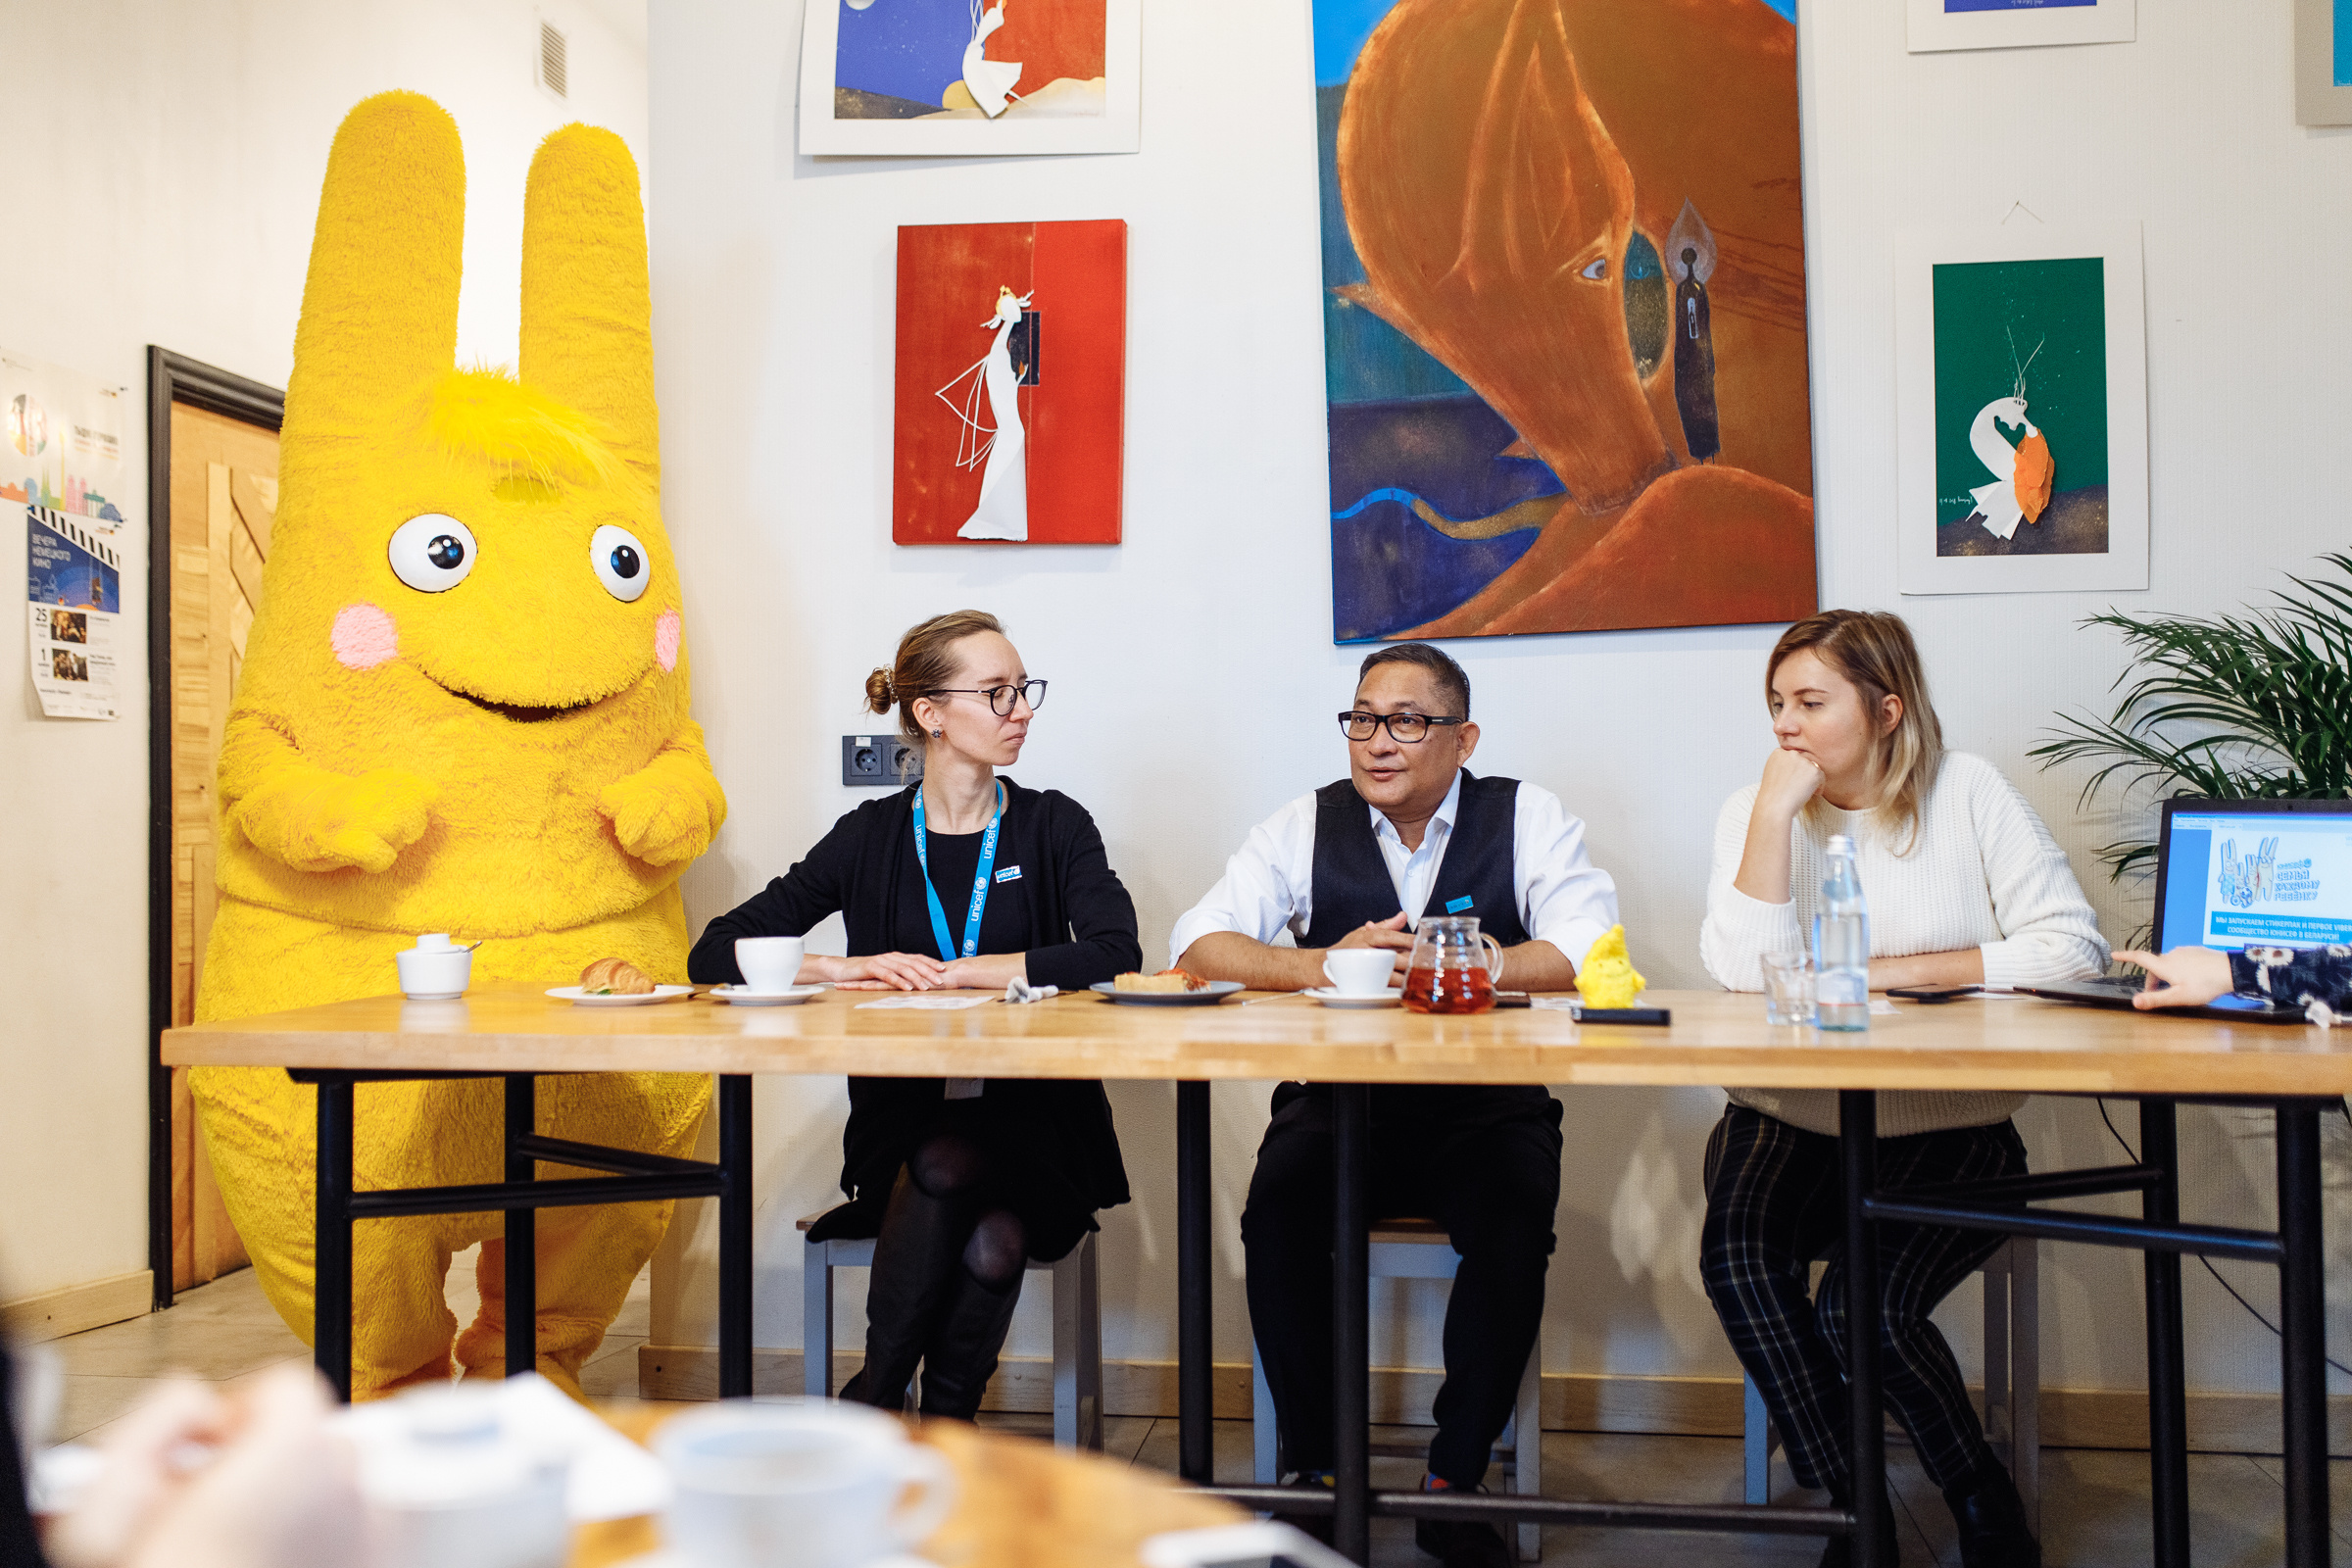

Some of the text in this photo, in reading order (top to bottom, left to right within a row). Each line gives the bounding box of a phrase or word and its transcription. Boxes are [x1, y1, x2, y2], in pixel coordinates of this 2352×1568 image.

[35, 608, 48, 622] 25
[915, 824, 925, 856] unicef
[984, 829, 997, 858] unicef
[2276, 869, 2310, 881] СЕМЬЯ
[2274, 880, 2321, 892] КАЖДОМУ
[971, 889, 985, 922] unicef
[2227, 926, 2270, 936] СООБЩЕСТВО
[2228, 917, 2264, 926] ЗАПУСКАЕМ
[2265, 919, 2301, 929] СТИКЕРПАК
[2308, 922, 2333, 931] ПЕРВОЕ
